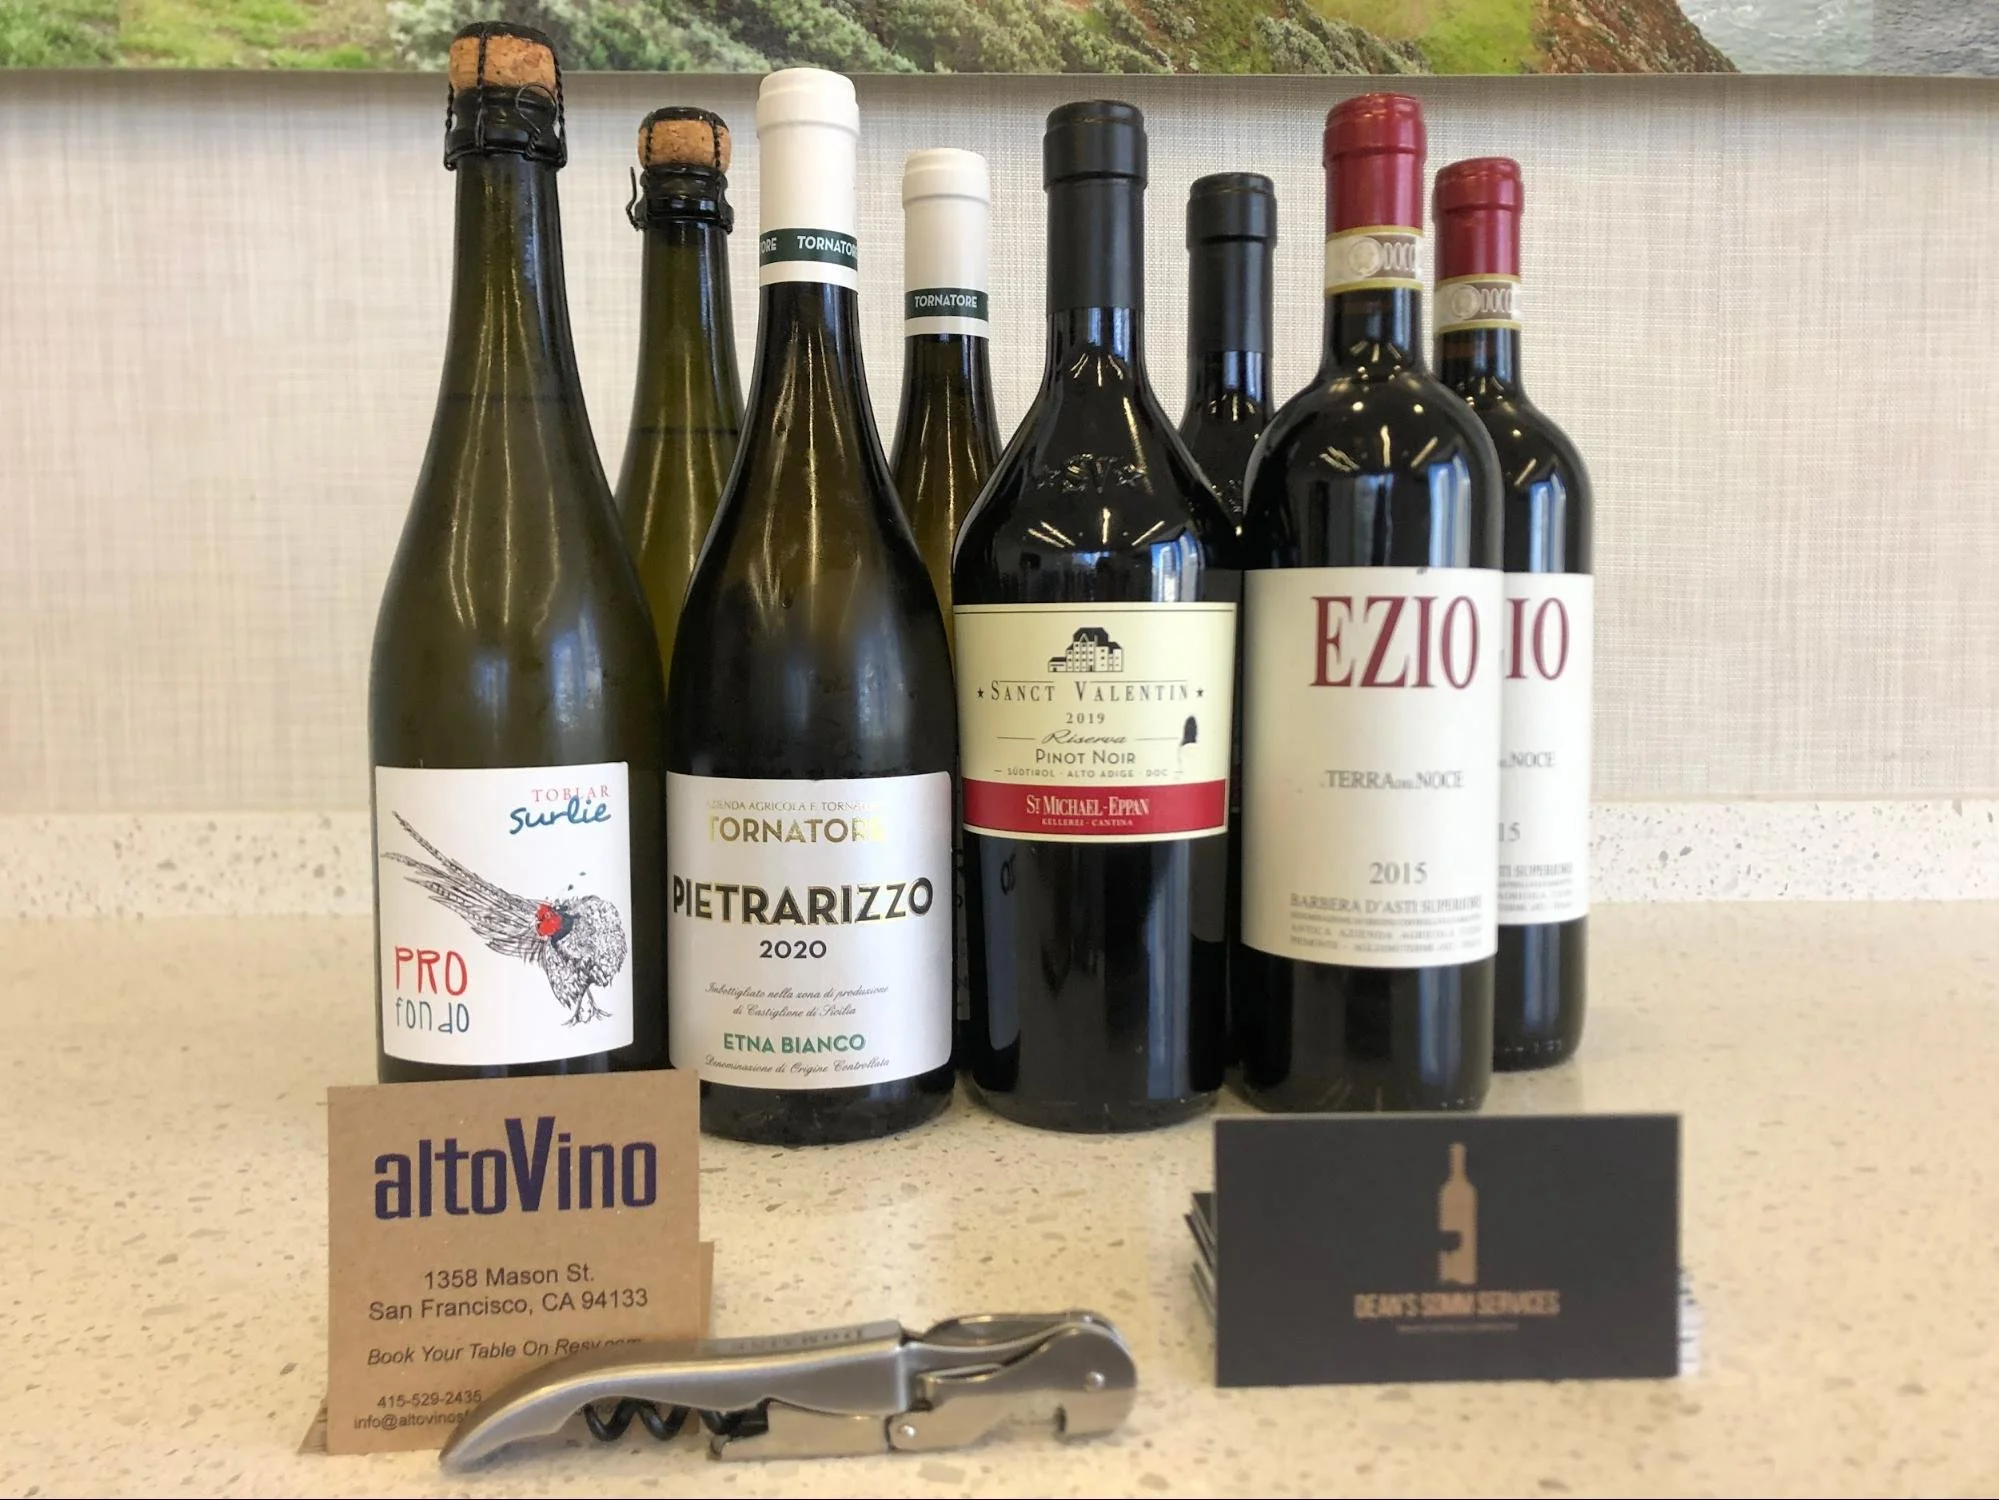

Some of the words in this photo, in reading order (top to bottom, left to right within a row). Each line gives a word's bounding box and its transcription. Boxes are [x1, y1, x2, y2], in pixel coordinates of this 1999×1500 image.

[797, 235, 858, 258] TORNATO
[914, 295, 978, 308] TORNATORE
[1309, 595, 1481, 690] EZIO
[1505, 597, 1570, 681] IO
[990, 681, 1056, 701] SANCT
[1074, 681, 1189, 701] VALENTIN
[1065, 712, 1106, 724] 2019
[1041, 729, 1128, 744] Riserva
[1035, 748, 1085, 765] PINOT
[1092, 750, 1136, 765] NOIR
[1008, 766, 1055, 778] SÜDTIROL
[1067, 769, 1095, 778] ALTO
[1100, 769, 1134, 778] ADIGE
[748, 801, 806, 811] AGRICOLA
[709, 815, 885, 843] TORNATOR
[1499, 823, 1521, 842] 15
[1369, 862, 1429, 885] 2015
[673, 874, 934, 925] PIETRARIZZO
[759, 940, 828, 959] 2020
[394, 946, 469, 996] PRO
[704, 982, 766, 1000] Imbottigliato
[767, 987, 794, 999] nella
[797, 990, 821, 999] zona
[823, 985, 835, 999] di
[834, 984, 889, 1001] produzione
[395, 996, 470, 1034] fondo
[732, 1004, 743, 1016] di
[746, 1003, 805, 1020] Castiglione
[806, 1005, 818, 1017] di
[819, 1003, 857, 1017] Sicilia
[723, 1032, 776, 1053] ETNA
[781, 1034, 867, 1054] BIANCO
[704, 1054, 773, 1073] Denominazione
[775, 1062, 787, 1073] di
[790, 1062, 829, 1078] Origine
[833, 1056, 891, 1073] Controllata
[374, 1116, 657, 1220] altoVino
[423, 1268, 478, 1290] 1358
[485, 1265, 559, 1288] Mason
[566, 1263, 595, 1283] St.
[368, 1301, 413, 1321] San
[420, 1296, 534, 1318] Francisco,
[542, 1295, 576, 1312] CA
[582, 1288, 649, 1309] 94133
[367, 1348, 414, 1365] Book
[421, 1345, 464, 1362] Your
[469, 1341, 517, 1359] Table
[522, 1339, 549, 1356] On
[554, 1337, 643, 1355] Resy
[377, 1390, 482, 1409] 415-529-2435
[353, 1409, 470, 1431] info@altovinos
